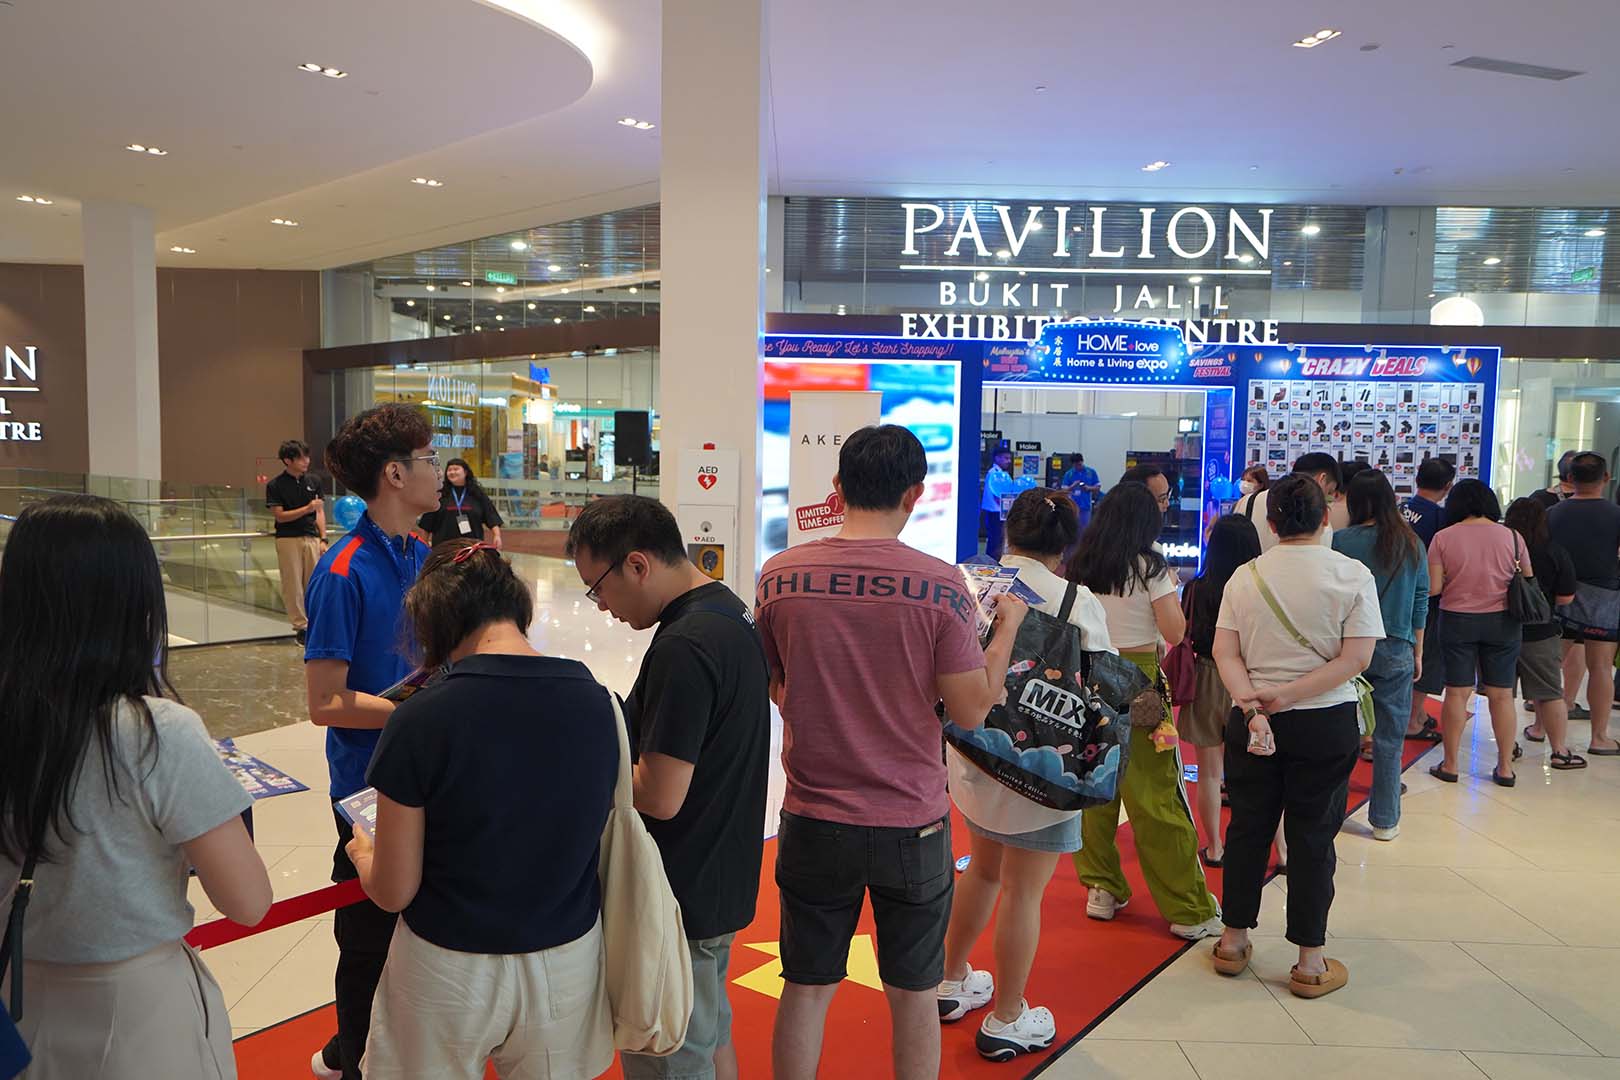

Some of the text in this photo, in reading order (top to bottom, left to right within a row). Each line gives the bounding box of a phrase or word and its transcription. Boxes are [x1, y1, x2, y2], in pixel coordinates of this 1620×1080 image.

[900, 202, 1274, 261] PAVILION
[939, 281, 1229, 313] BUKIT JALIL
[901, 312, 1280, 344] EXHIBIT NTRE
[775, 339, 799, 355] You
[801, 340, 843, 356] Ready?
[844, 341, 869, 356] Let's
[871, 342, 899, 354] Start
[900, 342, 954, 358] Shopping!!
[1078, 334, 1129, 351] HOME
[1067, 358, 1168, 373] Home & Living expo
[1189, 358, 1224, 367] SAVINGS
[1302, 356, 1429, 377] CRAZY DEALS
[1193, 366, 1231, 378] FESTIVAL
[1019, 442, 1037, 450] Haier
[698, 466, 718, 474] AED
[798, 505, 831, 520] LIMITED
[799, 516, 823, 530] TIME
